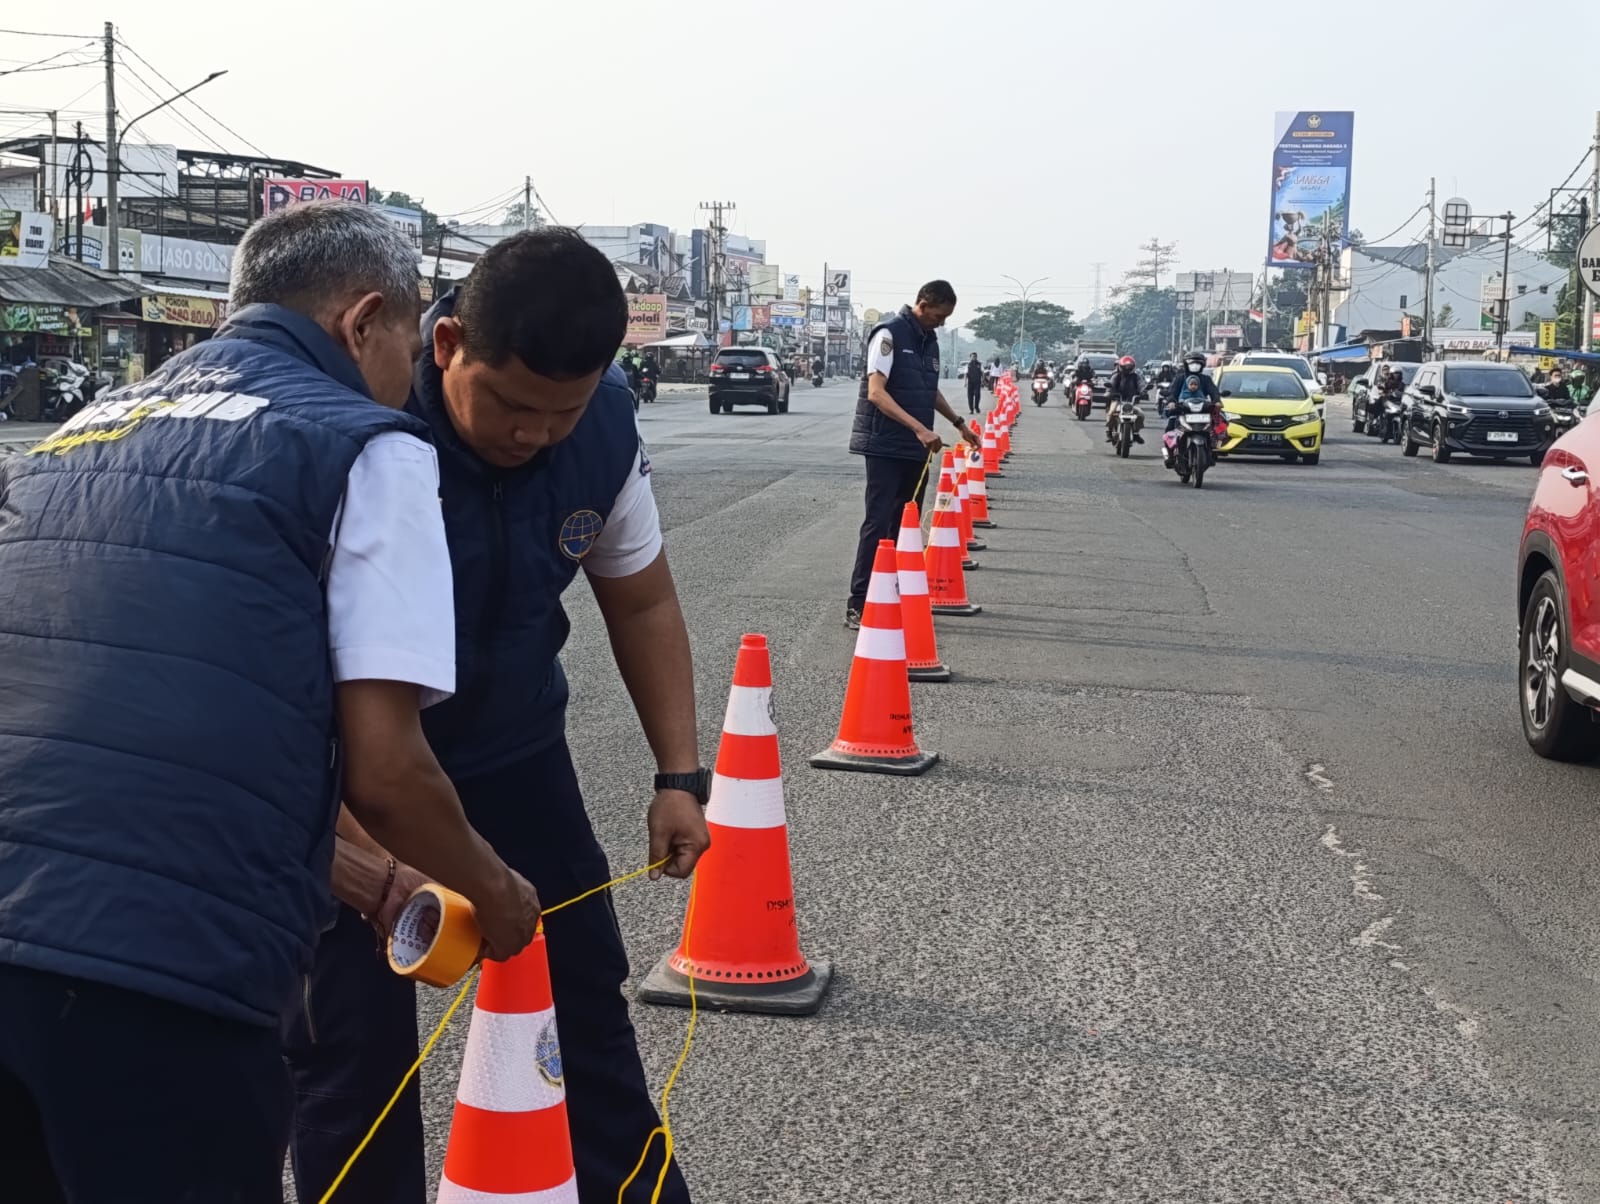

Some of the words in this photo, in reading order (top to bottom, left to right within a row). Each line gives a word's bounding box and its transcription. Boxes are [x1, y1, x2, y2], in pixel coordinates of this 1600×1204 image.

[157, 247, 192, 270] BASO
[195, 253, 228, 273] SOLO
[1447, 340, 1471, 350] AUTO
